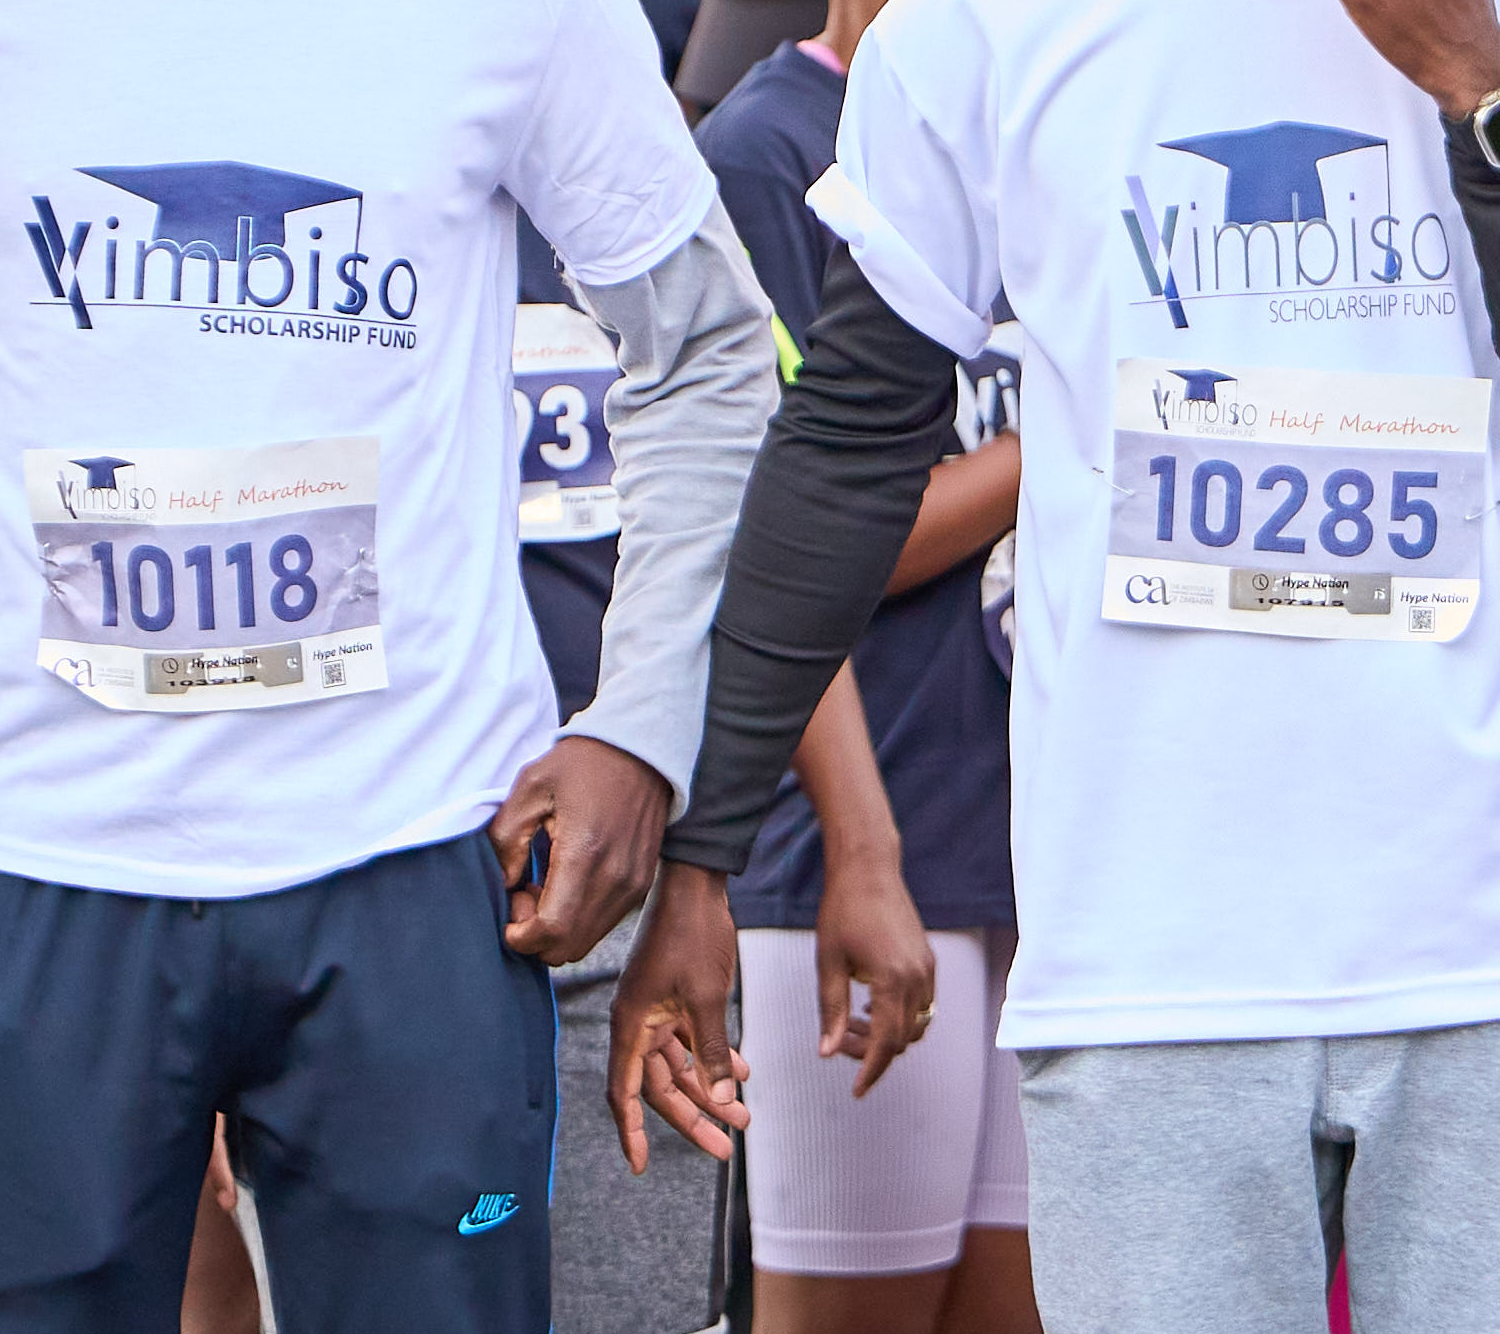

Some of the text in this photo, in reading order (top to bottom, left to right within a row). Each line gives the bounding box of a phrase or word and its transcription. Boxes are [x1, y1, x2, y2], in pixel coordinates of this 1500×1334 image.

[1269, 291, 1456, 323] SCHOLARSHIP FUND
[199, 315, 417, 349] SCHOLARSHIP FUND
[1269, 408, 1461, 435] Half Marathon
[168, 480, 348, 512] Half Marathon
[1149, 455, 1439, 560] 10285
[91, 534, 318, 632] 10118
[1124, 574, 1171, 605] ca
[1282, 576, 1349, 589] Hype Nation
[1400, 590, 1469, 604] Hype Nation
[191, 655, 259, 669] Hype Nation
[312, 641, 373, 661] Hype Nation
[471, 1193, 516, 1220] NIKE
